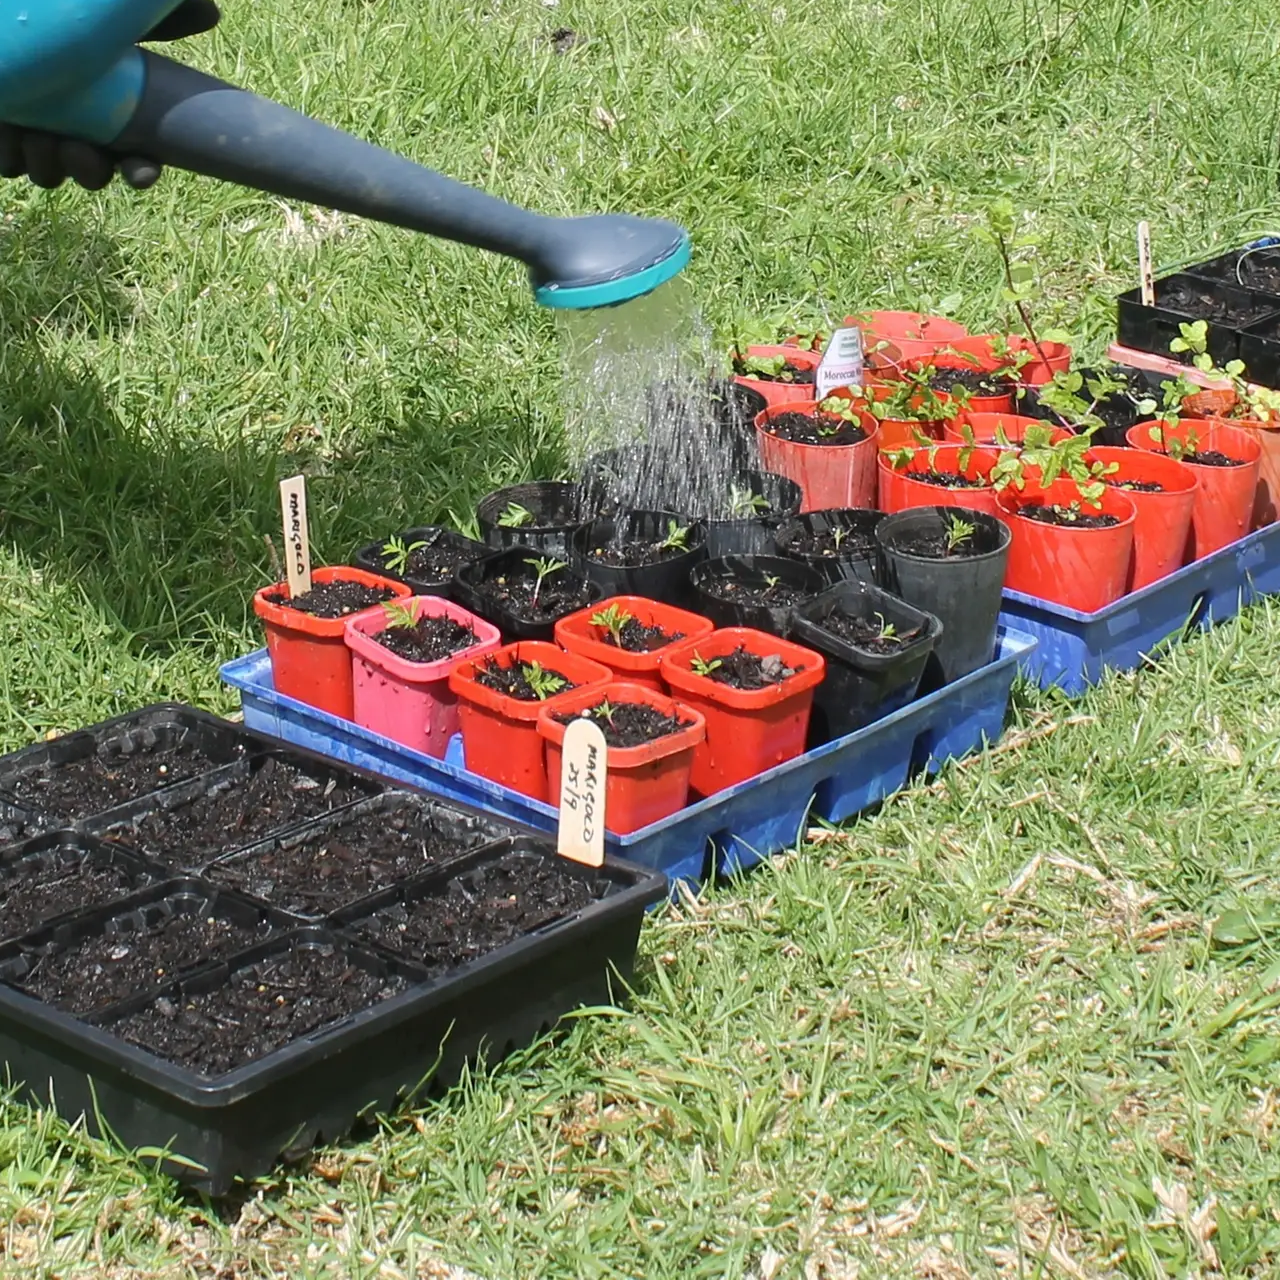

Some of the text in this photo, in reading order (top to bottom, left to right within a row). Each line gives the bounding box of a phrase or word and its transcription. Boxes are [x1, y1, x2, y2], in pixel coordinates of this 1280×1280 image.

[289, 493, 305, 575] MARIGOLD
[563, 761, 581, 810] 25/9
[581, 744, 598, 844] MARIGOLD
